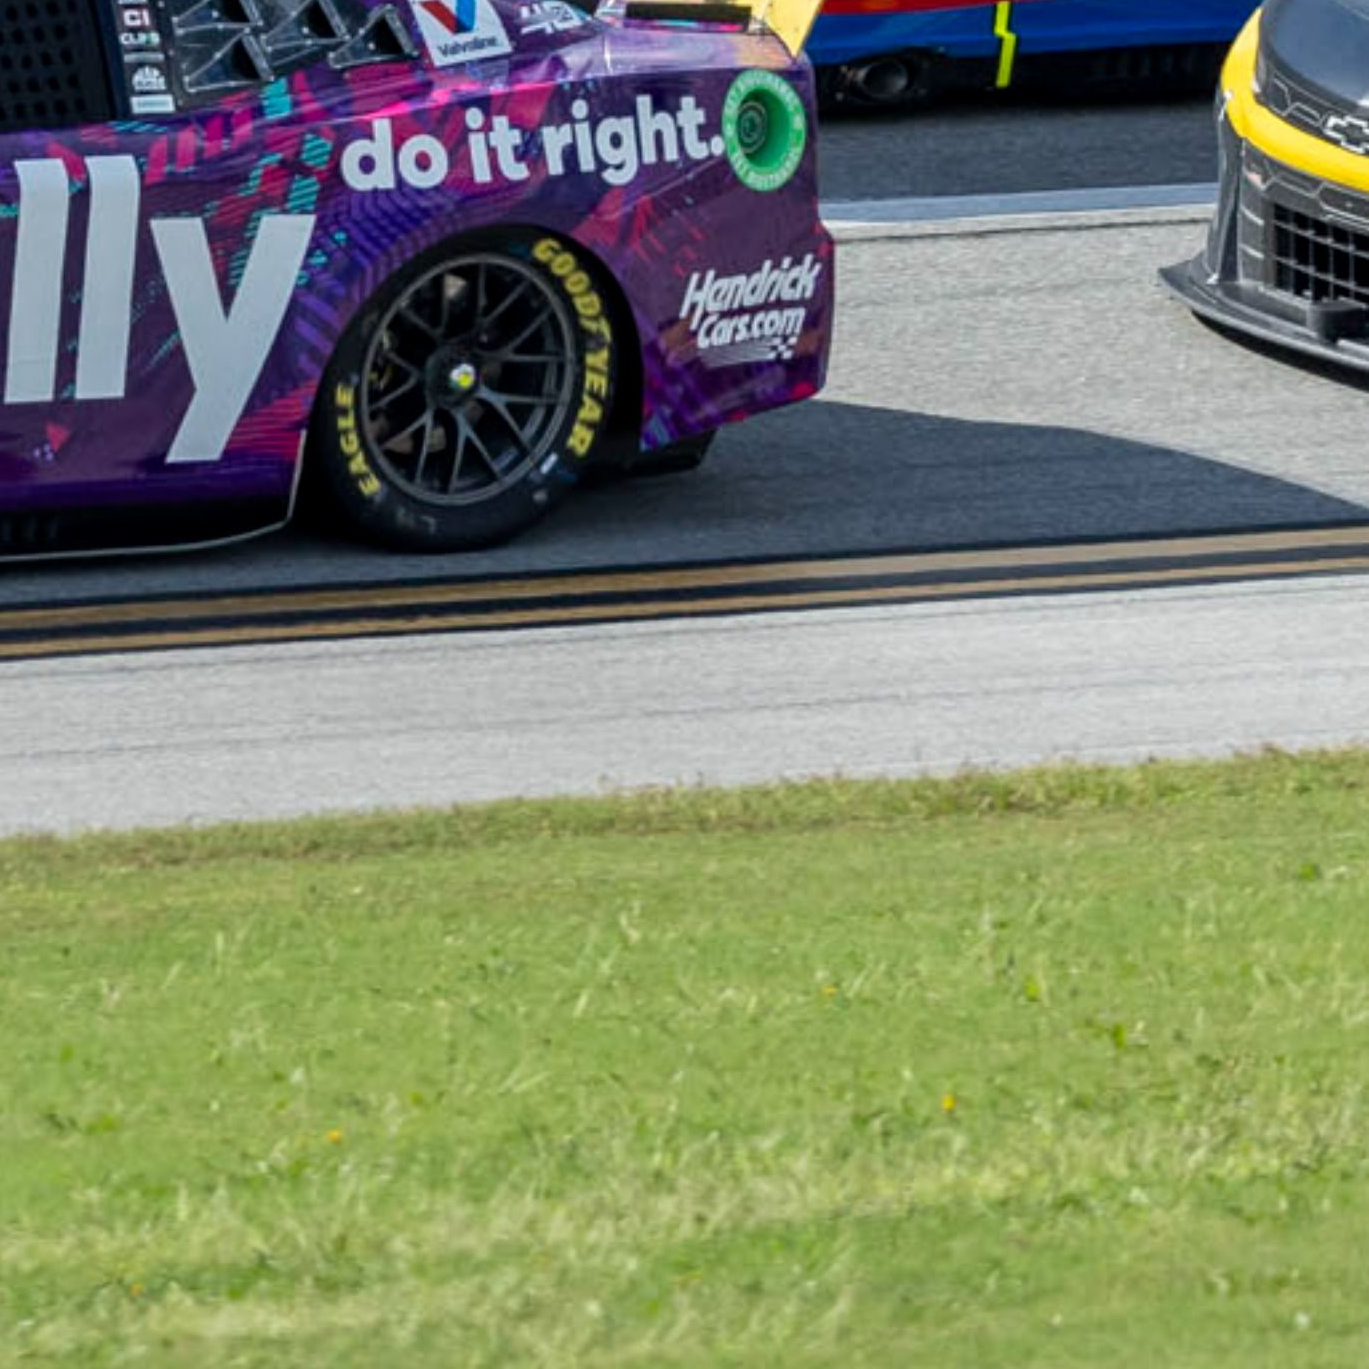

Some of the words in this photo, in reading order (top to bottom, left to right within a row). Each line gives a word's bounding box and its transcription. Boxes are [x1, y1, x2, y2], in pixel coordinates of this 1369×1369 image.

[437, 34, 500, 58] Valvoline
[341, 119, 448, 191] do
[466, 107, 530, 183] it
[542, 94, 725, 185] right.
[679, 252, 823, 331] Hendrick
[696, 307, 806, 349] Cars.com
[533, 237, 613, 457] GOODYEAR
[334, 383, 382, 497] EAGLE
